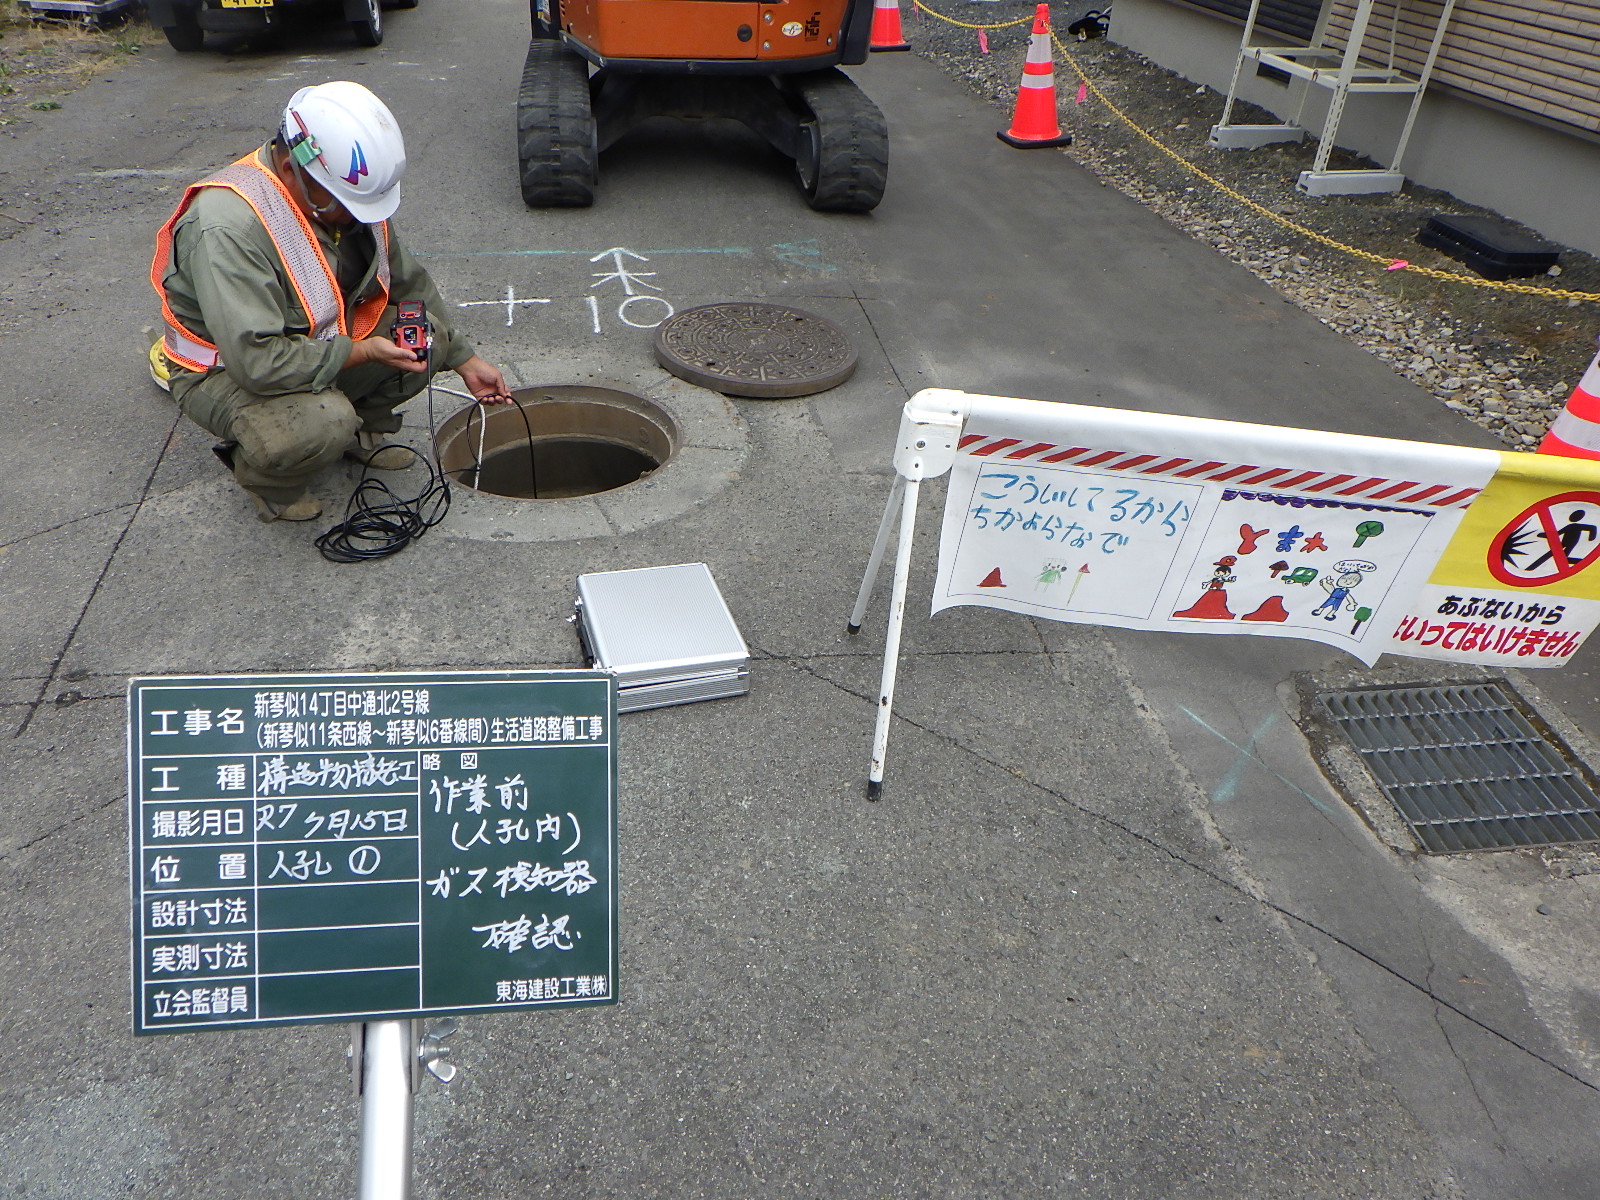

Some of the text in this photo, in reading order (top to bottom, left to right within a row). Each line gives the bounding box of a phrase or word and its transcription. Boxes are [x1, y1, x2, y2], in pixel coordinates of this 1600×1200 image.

[1437, 594, 1566, 626] あぶないから
[253, 688, 430, 719] 新琴似14丁目中通北2号線
[150, 707, 245, 736] 工事名
[429, 773, 529, 815] 作業前
[151, 808, 244, 839] 撮影月日
[451, 812, 581, 856] (人孔内)
[151, 896, 248, 929] 設計寸法
[471, 913, 582, 954] 確認
[151, 941, 248, 974] 実測寸法
[152, 986, 249, 1018] 立会監督員
